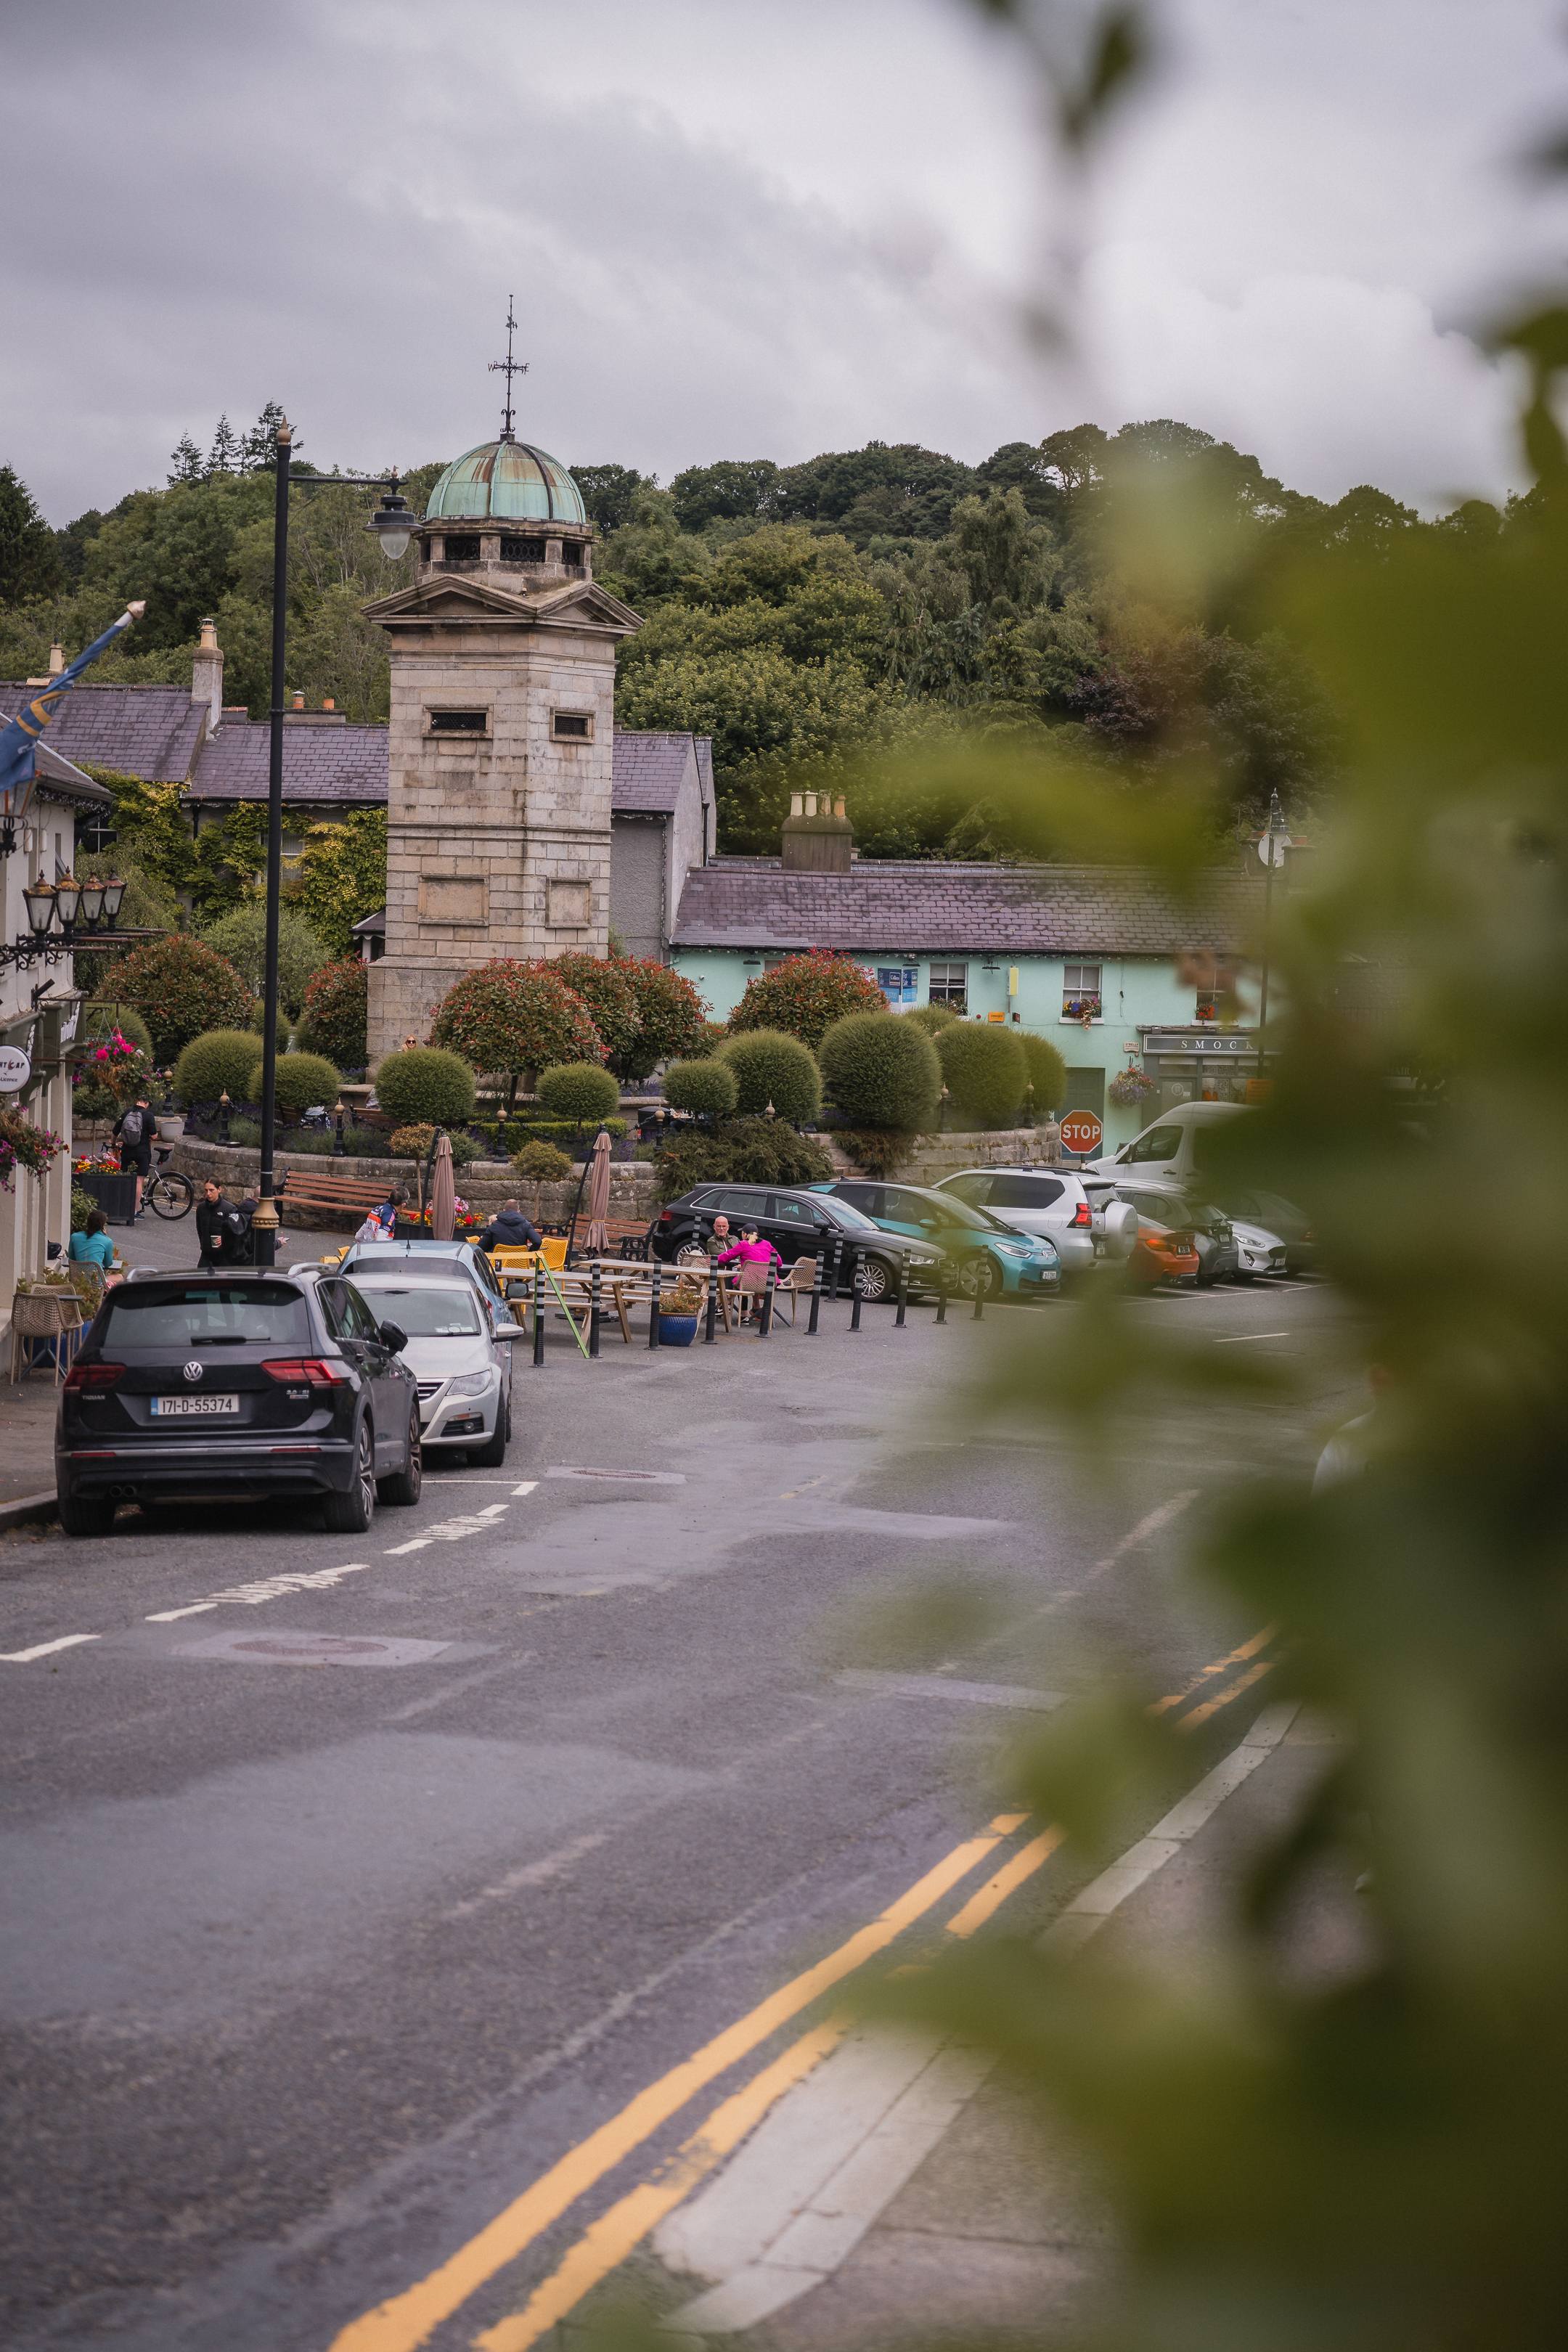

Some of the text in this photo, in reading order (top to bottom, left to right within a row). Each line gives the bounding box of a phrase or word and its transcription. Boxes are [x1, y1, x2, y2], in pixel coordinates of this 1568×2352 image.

[1181, 1040, 1253, 1050] SMOCK
[1062, 1124, 1100, 1139] STOP
[163, 1398, 232, 1413] 171-D-55374
